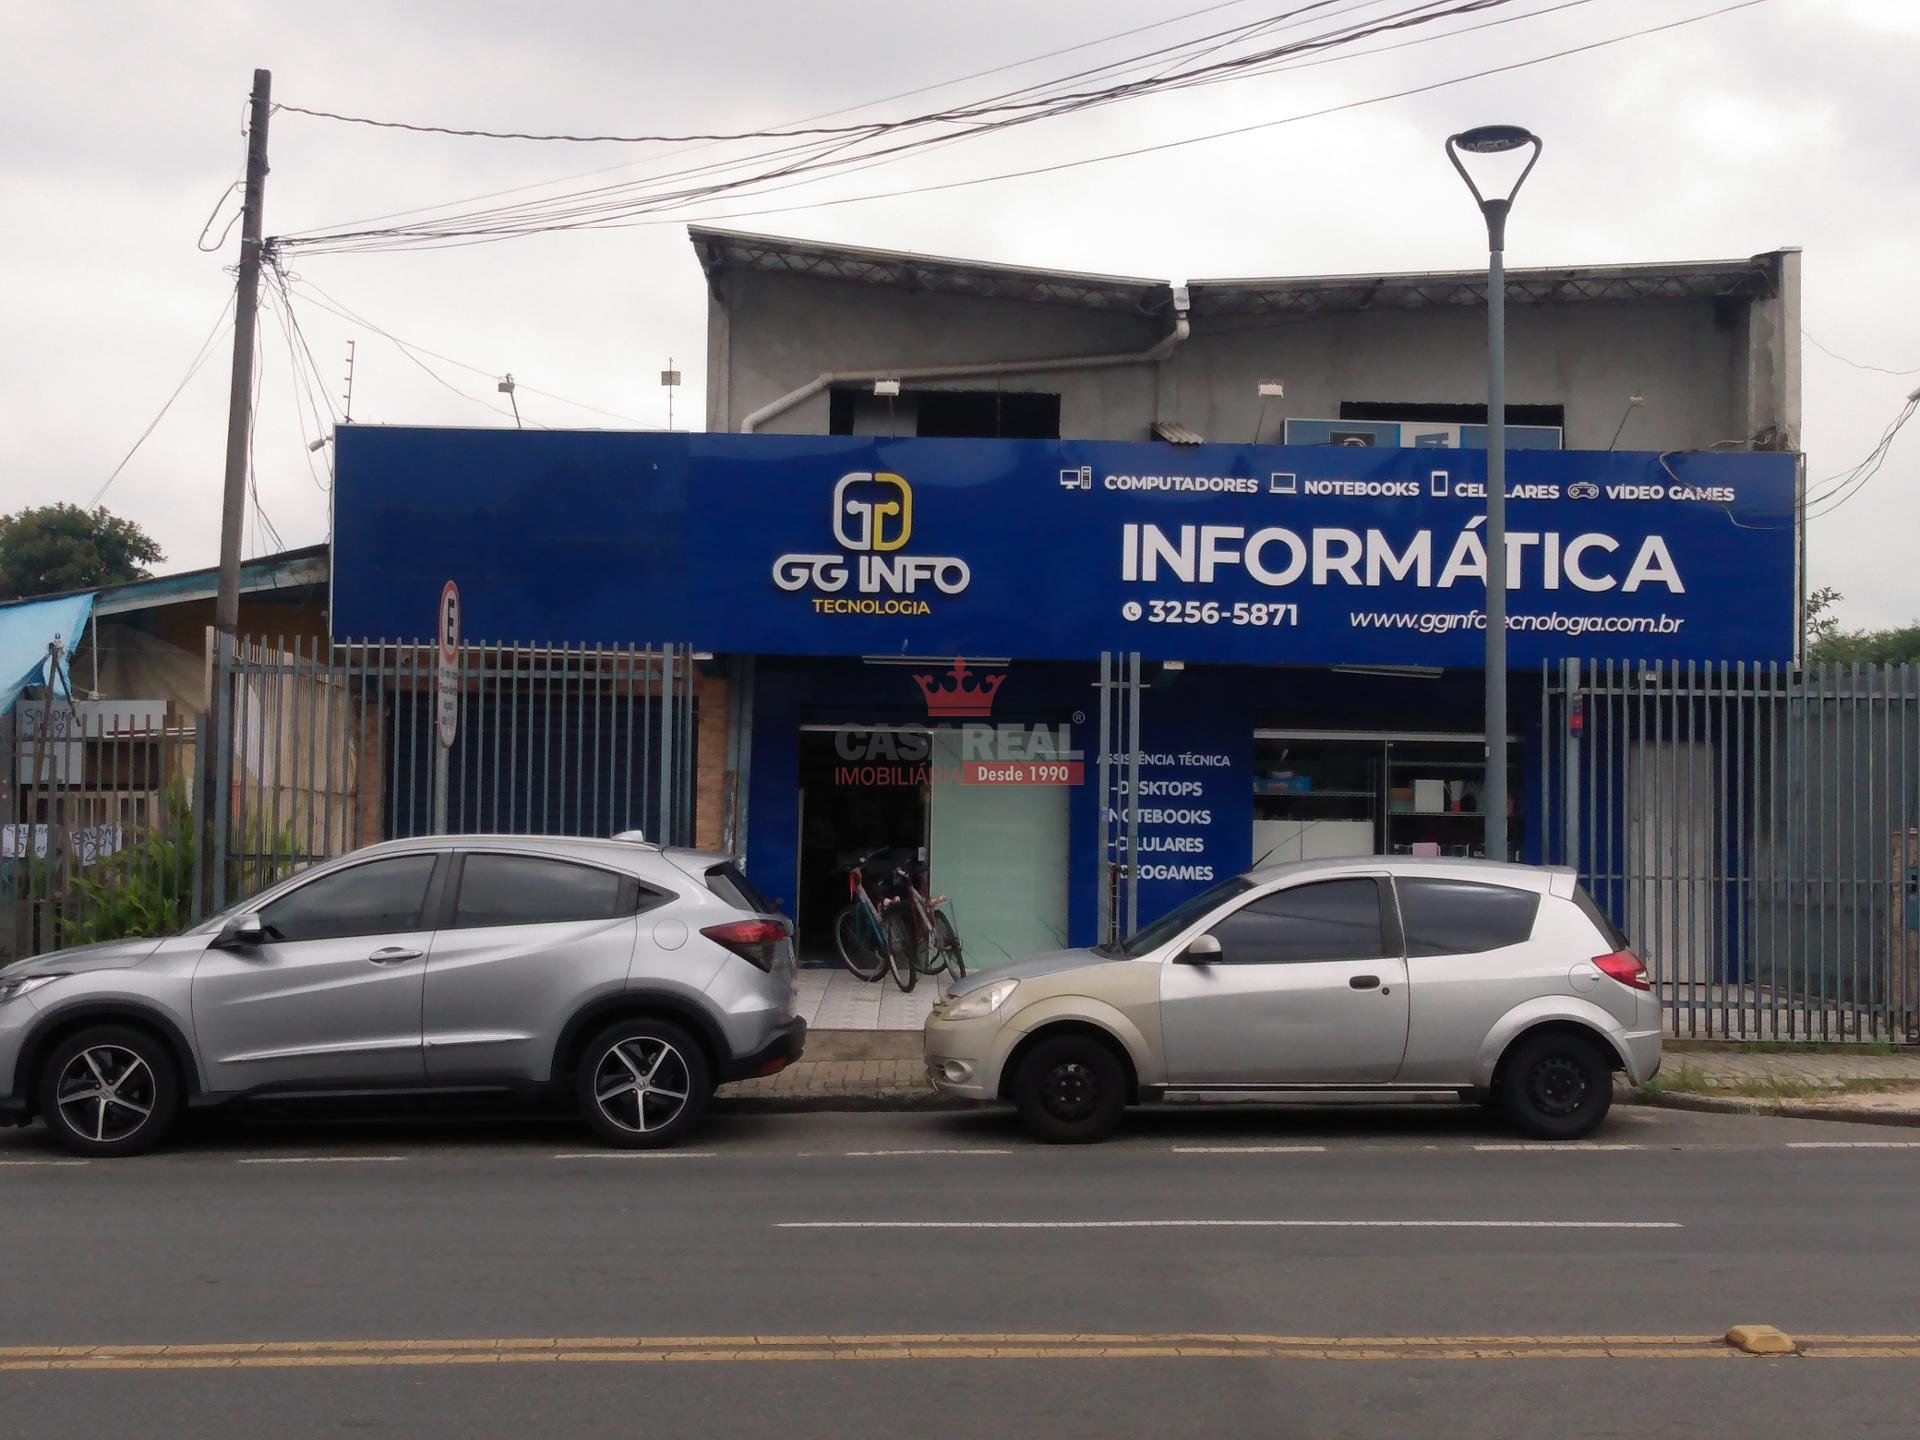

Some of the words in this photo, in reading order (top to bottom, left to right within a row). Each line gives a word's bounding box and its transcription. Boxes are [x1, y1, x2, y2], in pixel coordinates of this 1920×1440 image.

[1104, 475, 1259, 494] COMPUTADORES
[1304, 480, 1420, 497] NOTEBOOKS
[1454, 483, 1560, 500] CELLARES
[1605, 483, 1665, 500] VÍDEO
[1668, 486, 1735, 502] GAMES
[1122, 515, 1686, 594] INFORMÁTICA
[772, 554, 849, 592] GG
[859, 555, 971, 594] INFO
[812, 599, 931, 615] TECNOLOGIA
[1147, 601, 1298, 627] 3256-5871
[1350, 610, 1685, 636] www.gginfocnologia.com.br
[1096, 751, 1175, 766] SSISÊNCIA
[1178, 752, 1231, 767] TÉCNICA
[1110, 780, 1203, 797] -DSKTOPS
[1108, 836, 1205, 853] -CLULARES
